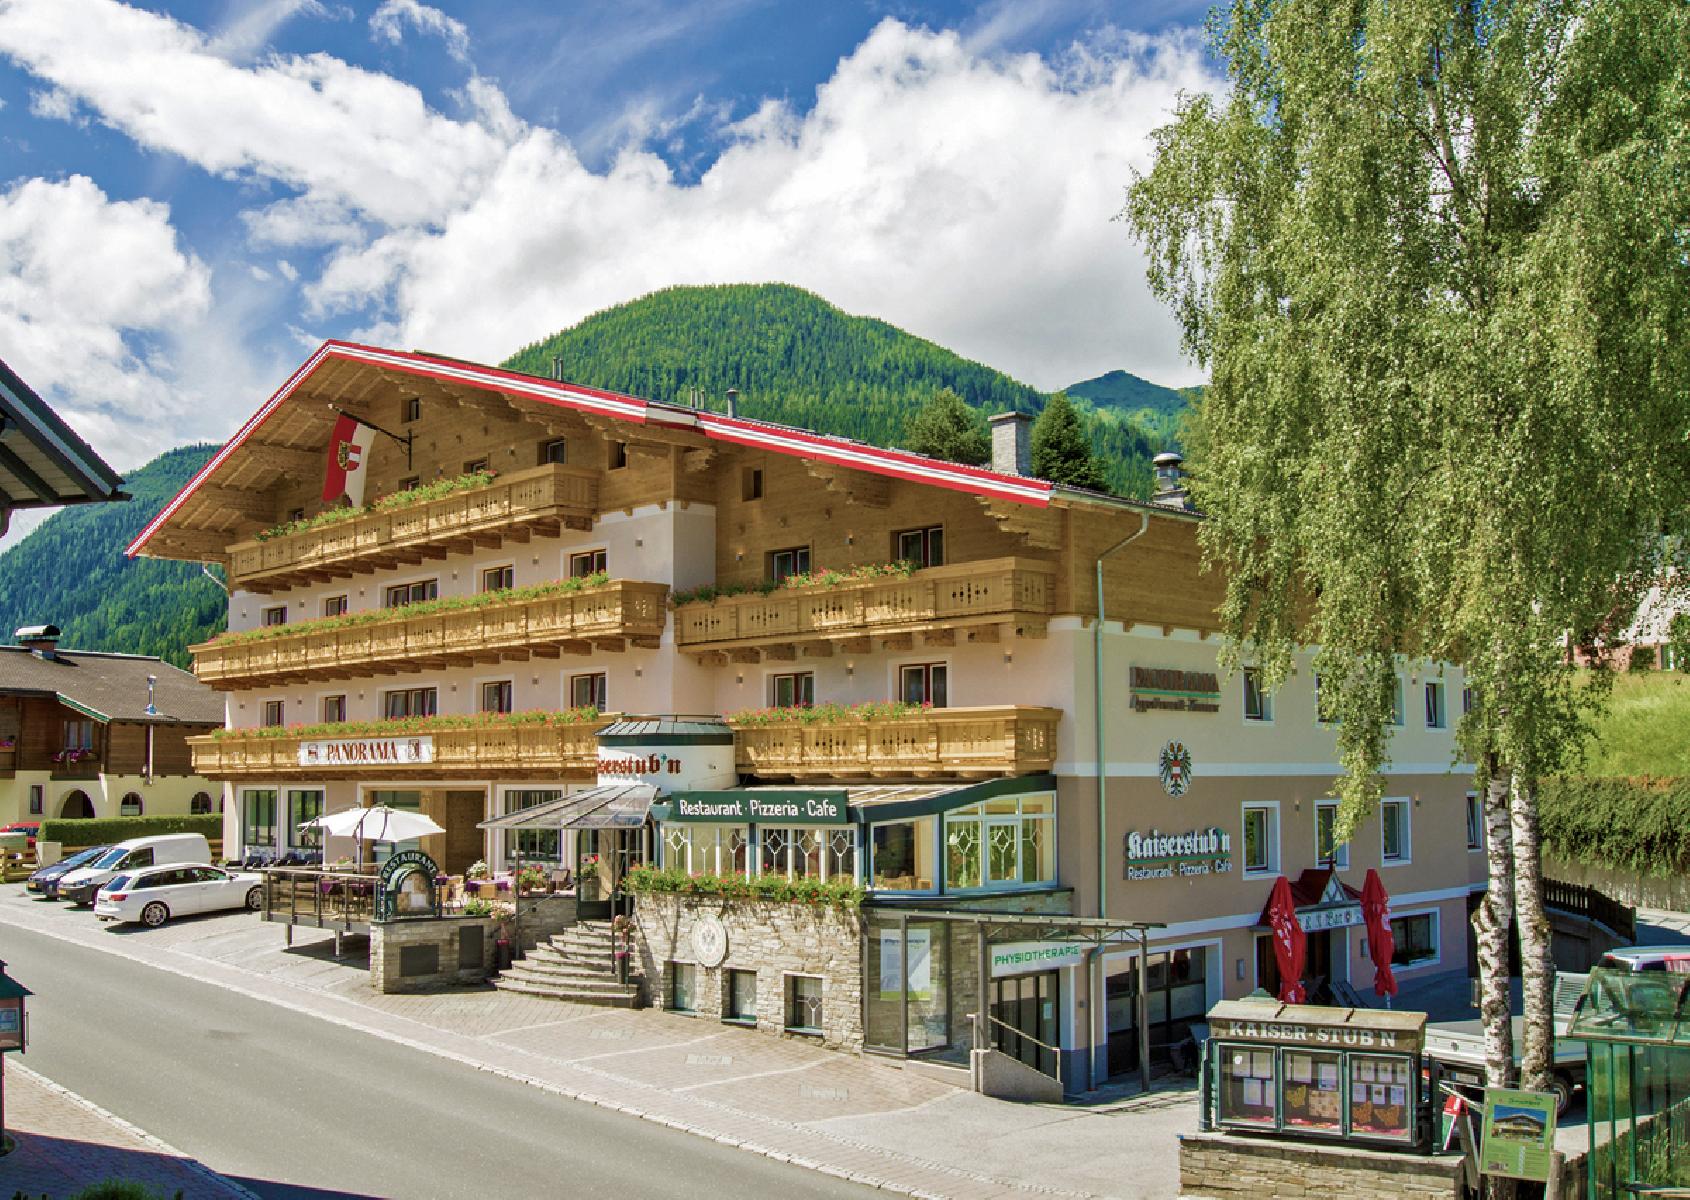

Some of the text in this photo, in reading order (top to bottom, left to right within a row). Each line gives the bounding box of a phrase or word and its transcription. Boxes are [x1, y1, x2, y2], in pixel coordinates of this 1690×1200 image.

[326, 741, 398, 762] PANORAMA
[596, 752, 682, 775] serstub'n
[679, 799, 837, 817] Restaurant Pizzeria Cafe
[994, 945, 1080, 966] PHYSIOTHERAPIE
